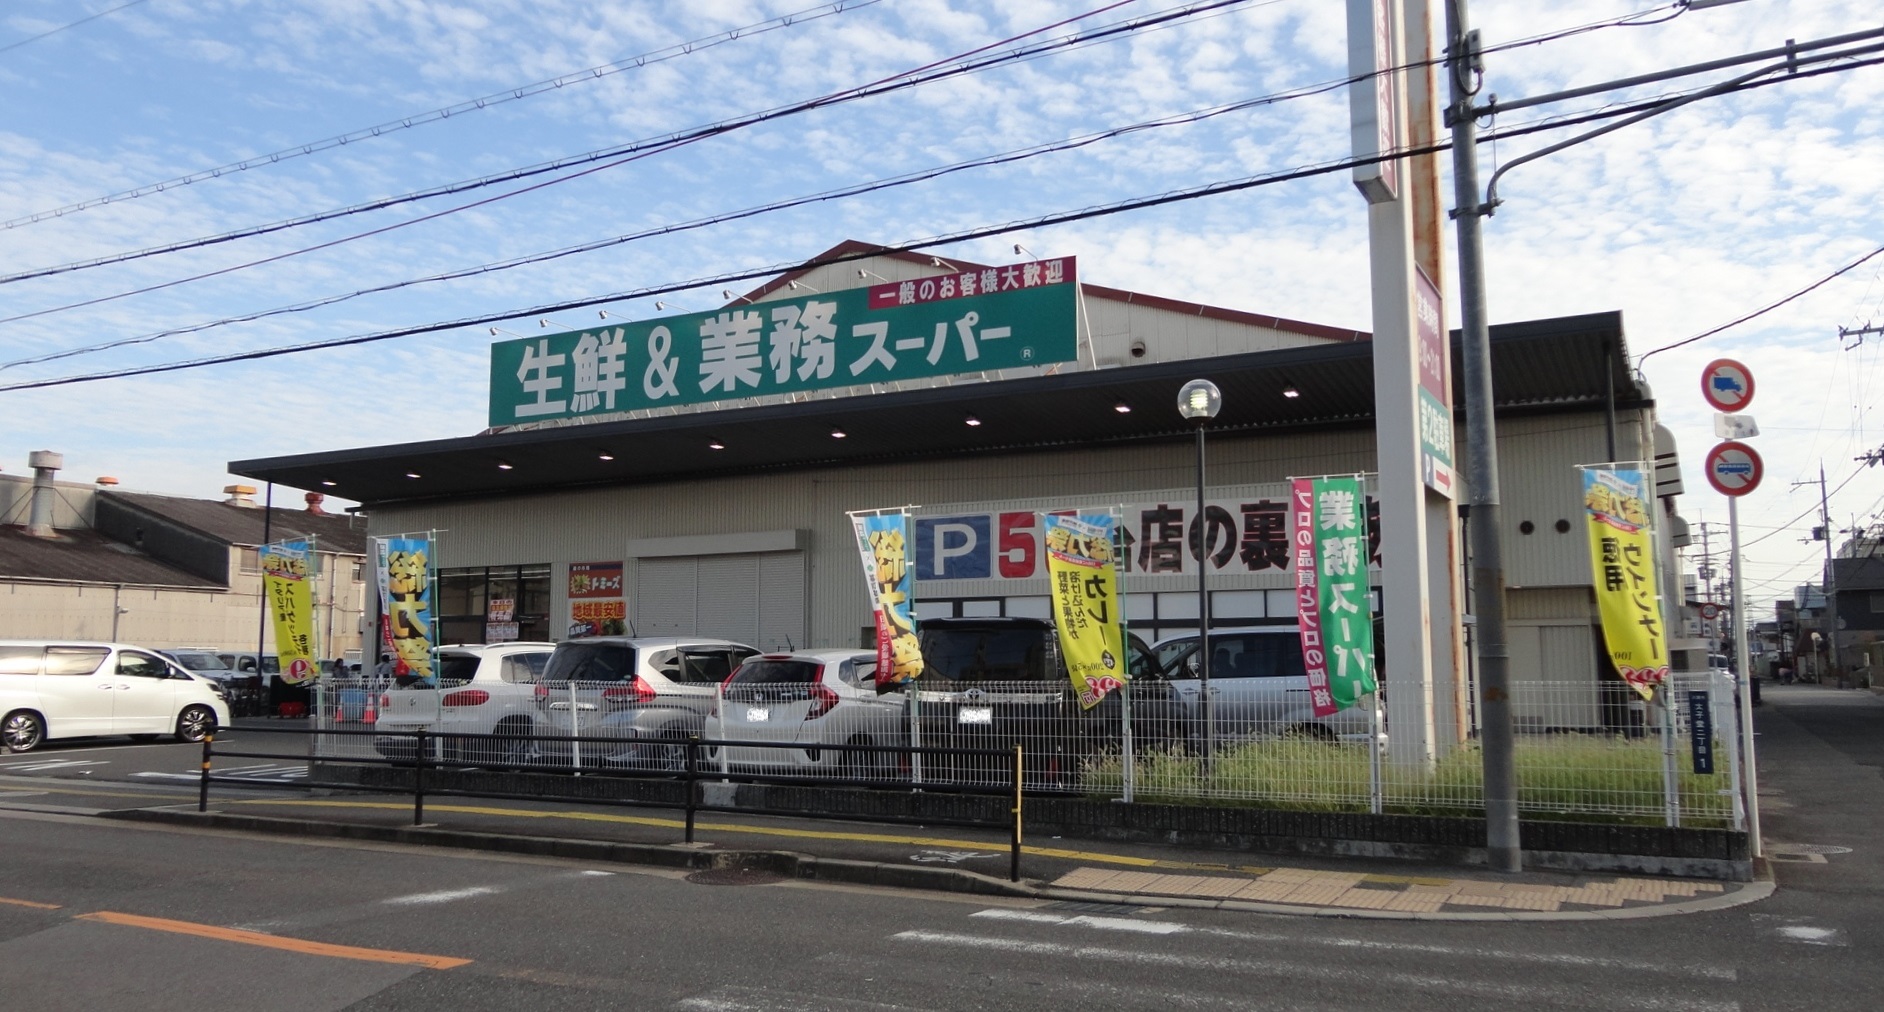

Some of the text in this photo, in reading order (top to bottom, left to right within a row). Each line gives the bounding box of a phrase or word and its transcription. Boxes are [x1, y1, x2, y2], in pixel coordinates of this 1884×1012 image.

[879, 260, 1063, 305] 一般のお客様大歓迎
[933, 524, 977, 576] P
[592, 575, 621, 591] トミーズ
[573, 601, 626, 620] 地域最安値
